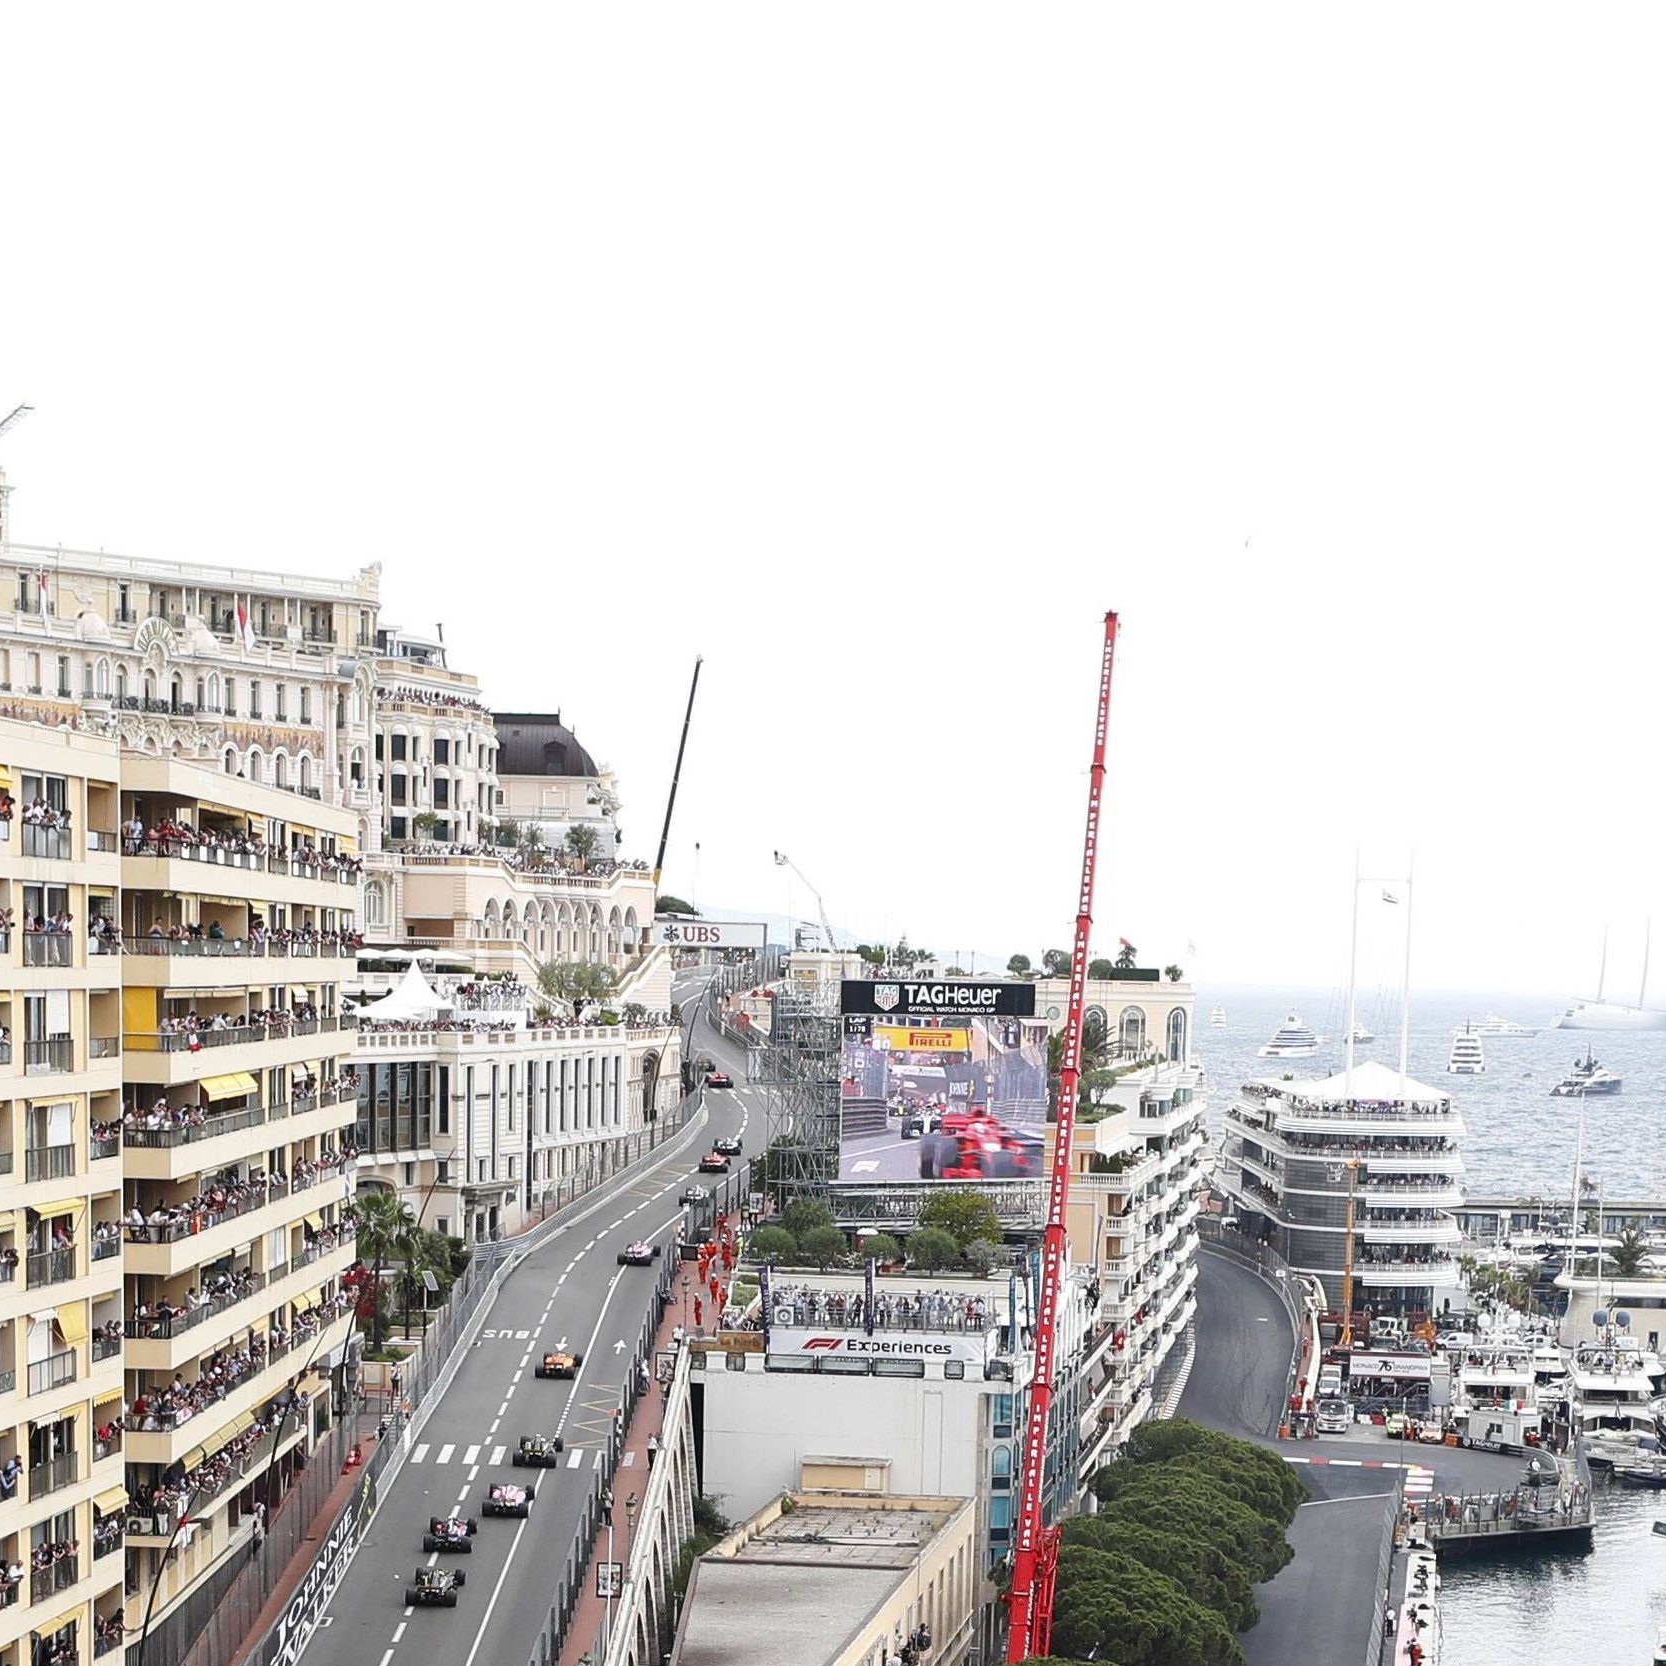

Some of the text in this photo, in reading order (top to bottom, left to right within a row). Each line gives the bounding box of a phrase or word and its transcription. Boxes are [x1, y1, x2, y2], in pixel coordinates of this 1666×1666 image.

[1086, 788, 1099, 865] IMPERIAL
[683, 926, 721, 942] UBS
[1072, 931, 1085, 1009] IMPERIAL
[909, 1032, 952, 1047] PIRELLI
[1058, 1086, 1071, 1166] IMPERIAL
[1044, 1243, 1057, 1325] IMPERIAL
[482, 1329, 530, 1339] BUS
[847, 1338, 952, 1355] Experiences
[1029, 1404, 1042, 1487] IMPERIAL
[270, 1505, 353, 1666] JOHNNIE
